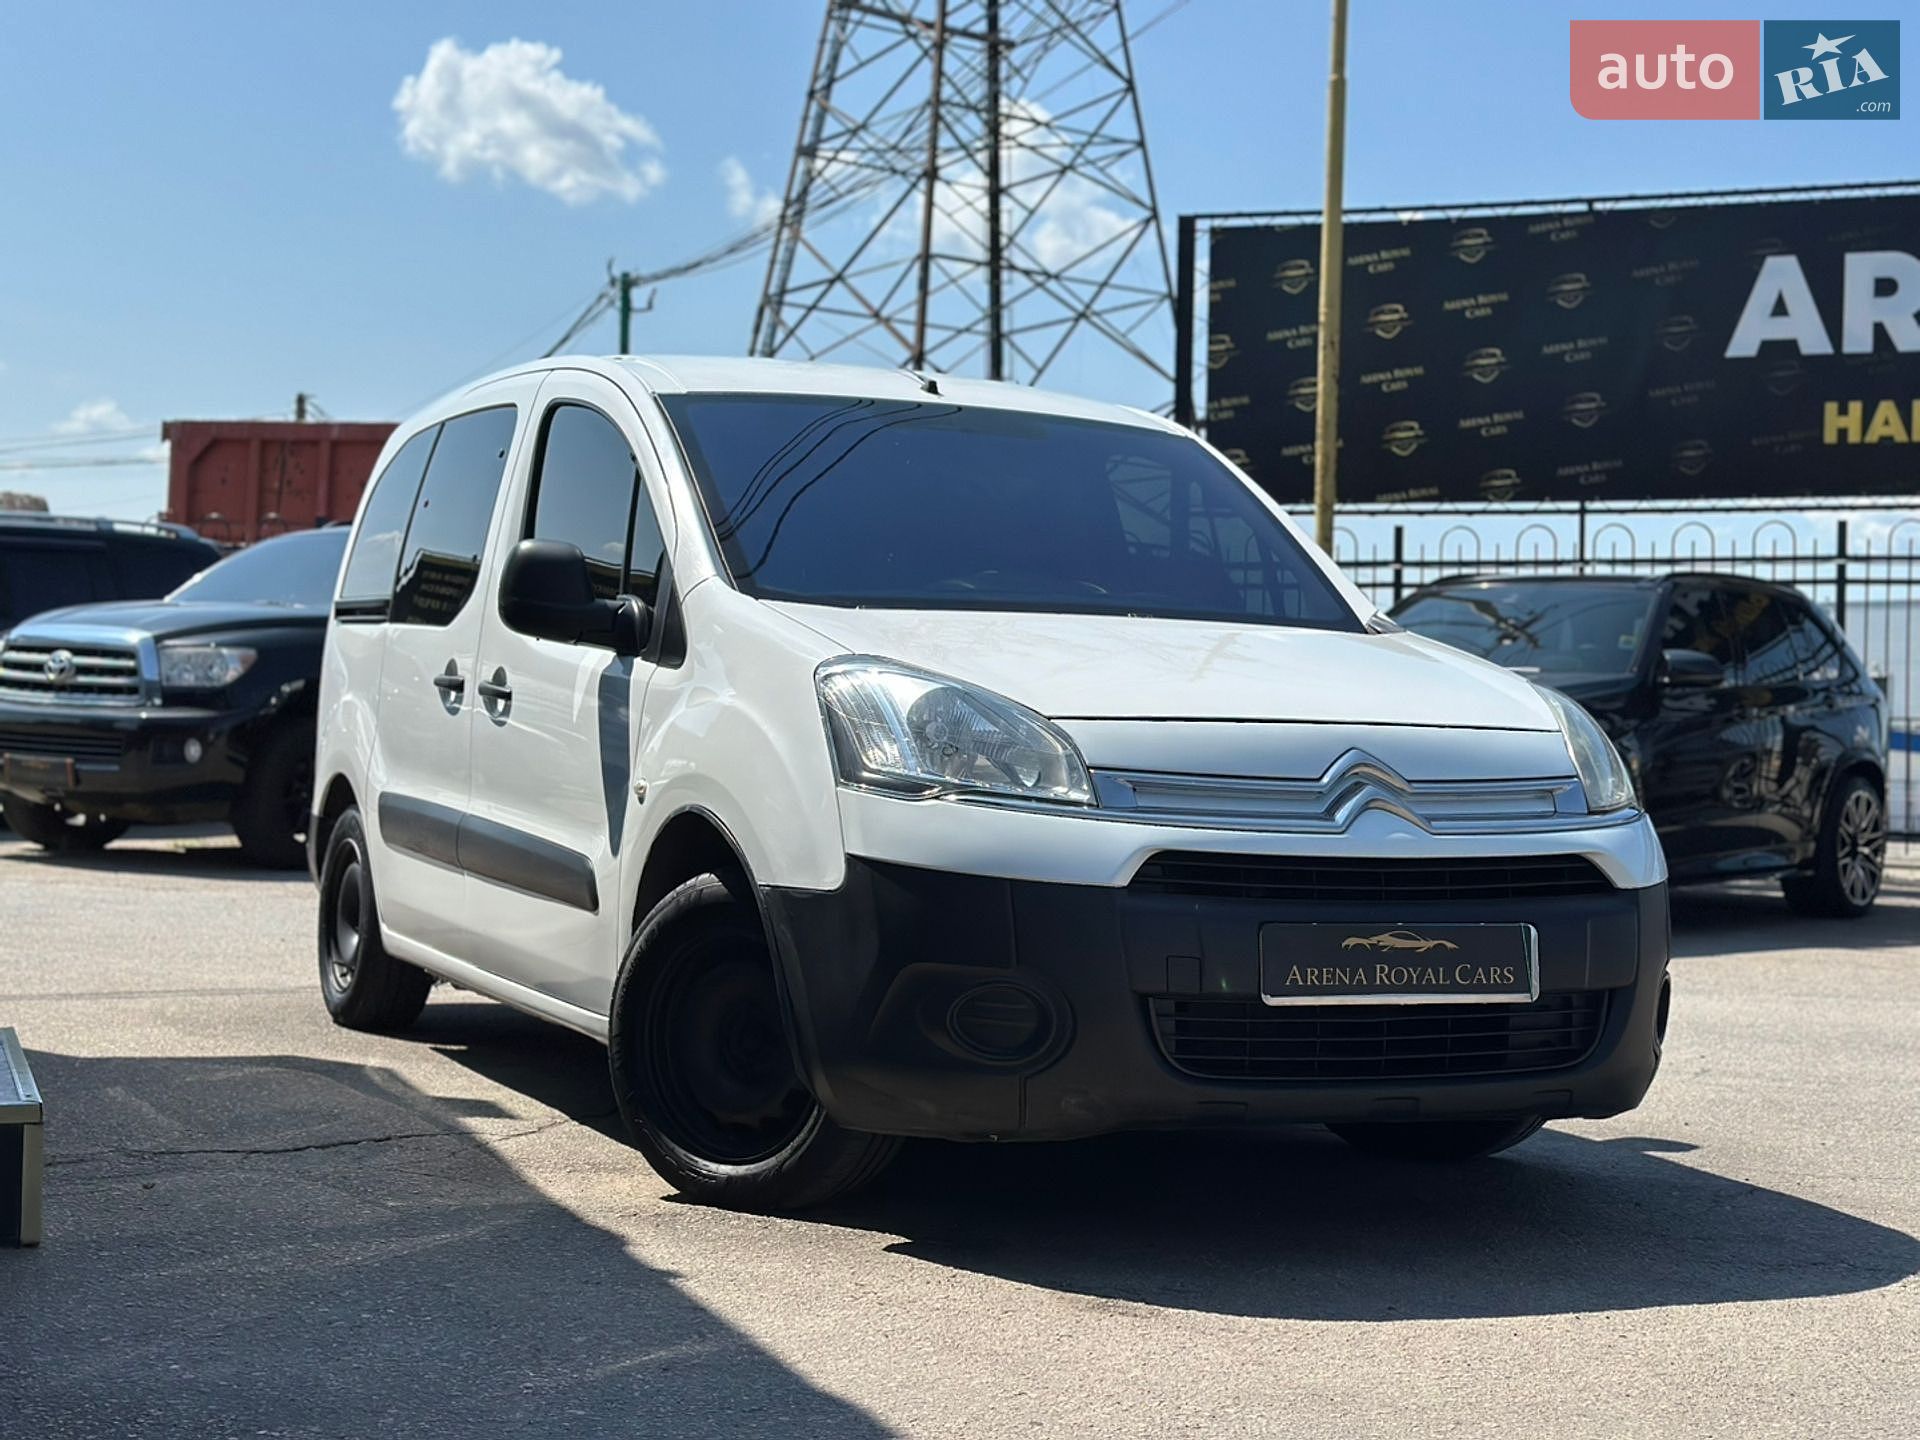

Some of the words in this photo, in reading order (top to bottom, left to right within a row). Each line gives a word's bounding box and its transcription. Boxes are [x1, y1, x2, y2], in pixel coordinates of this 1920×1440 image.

[1285, 965, 1367, 985] ARENA
[1375, 964, 1449, 985] ROYAL
[1455, 964, 1515, 985] CARS
